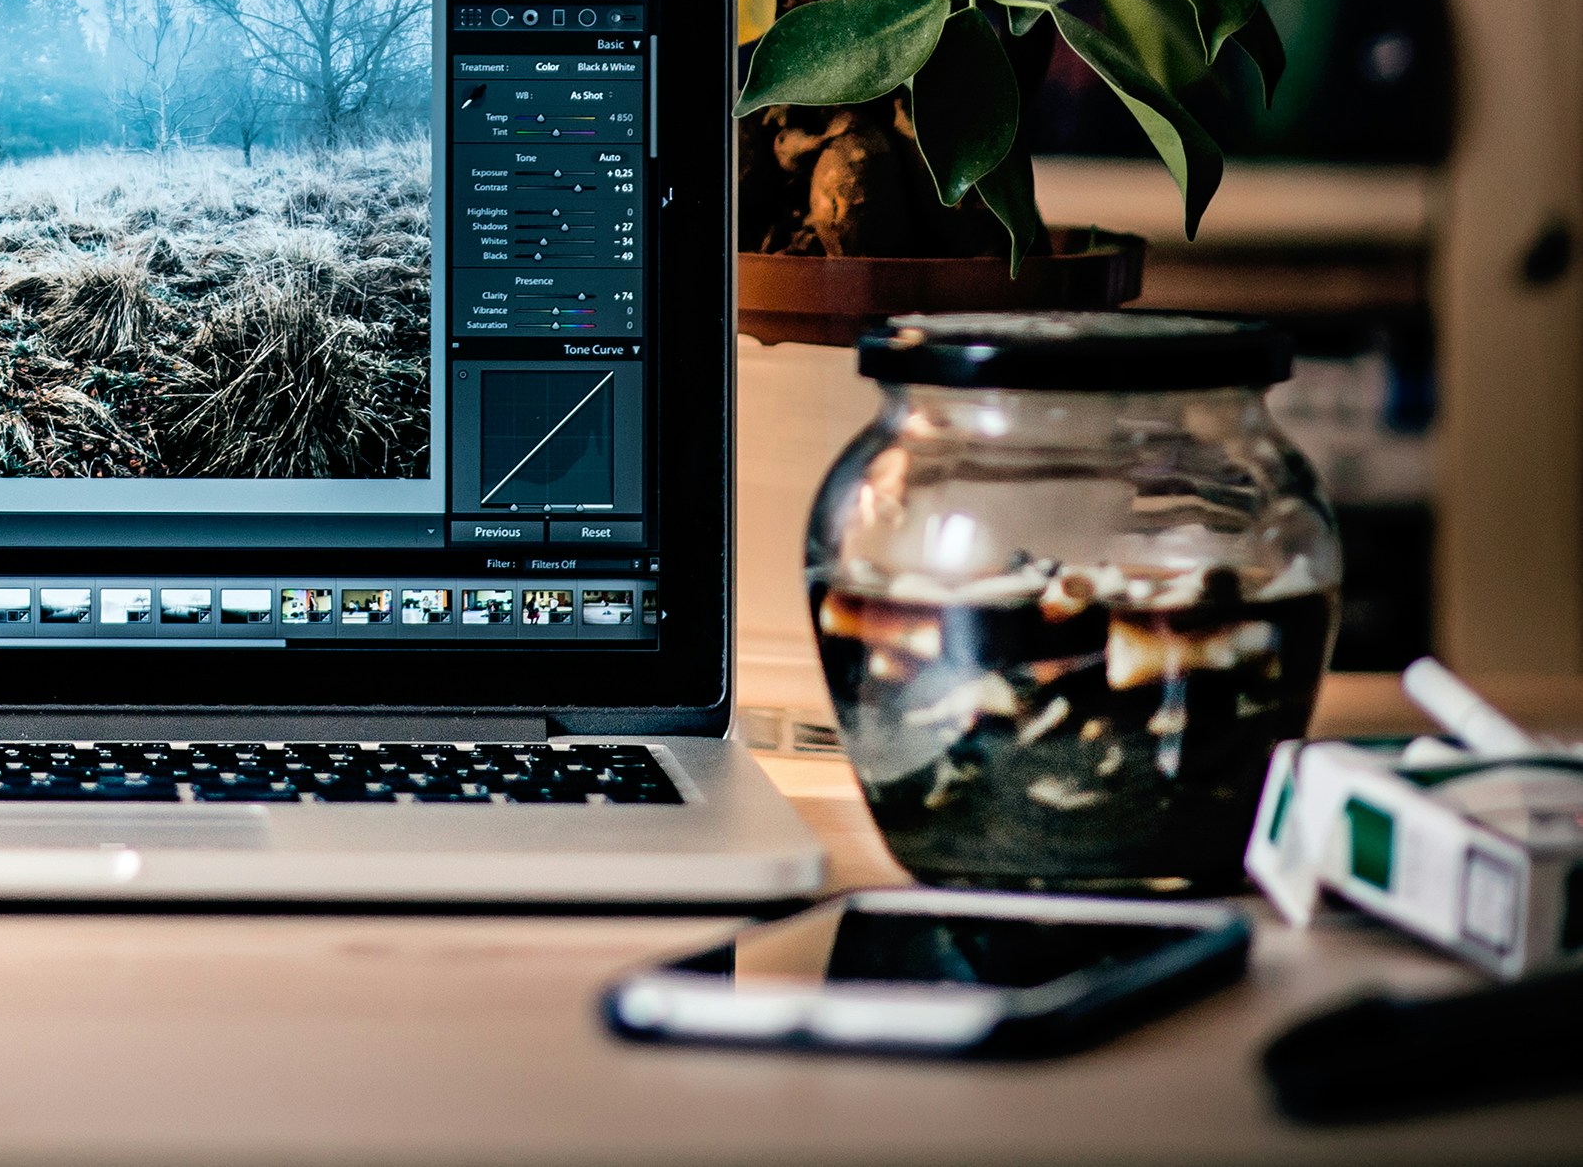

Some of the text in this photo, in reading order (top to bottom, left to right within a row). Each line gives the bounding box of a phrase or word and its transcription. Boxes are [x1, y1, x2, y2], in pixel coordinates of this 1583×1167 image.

[598, 38, 625, 49] Basic
[536, 62, 560, 71] Color
[578, 62, 601, 71] Black
[610, 62, 636, 71] White
[571, 90, 604, 99] As Shot
[486, 112, 509, 123] Temp
[493, 127, 508, 135] Tint
[516, 153, 538, 162] Tone
[599, 152, 622, 161] Auto
[472, 168, 509, 177] Exposure
[474, 183, 508, 191] Contrast
[468, 207, 508, 217] Highlights
[473, 222, 508, 230] Shadows
[481, 237, 508, 245] Whites
[484, 251, 508, 259] Blacks
[515, 276, 554, 285] Presence
[482, 291, 508, 301] Clarity
[473, 306, 508, 314] Vibrance
[467, 320, 508, 328] Saturation
[564, 344, 624, 354] Tone Curve
[475, 526, 521, 537] Previous
[582, 526, 612, 537] Reset
[532, 559, 577, 569] Filters Off
